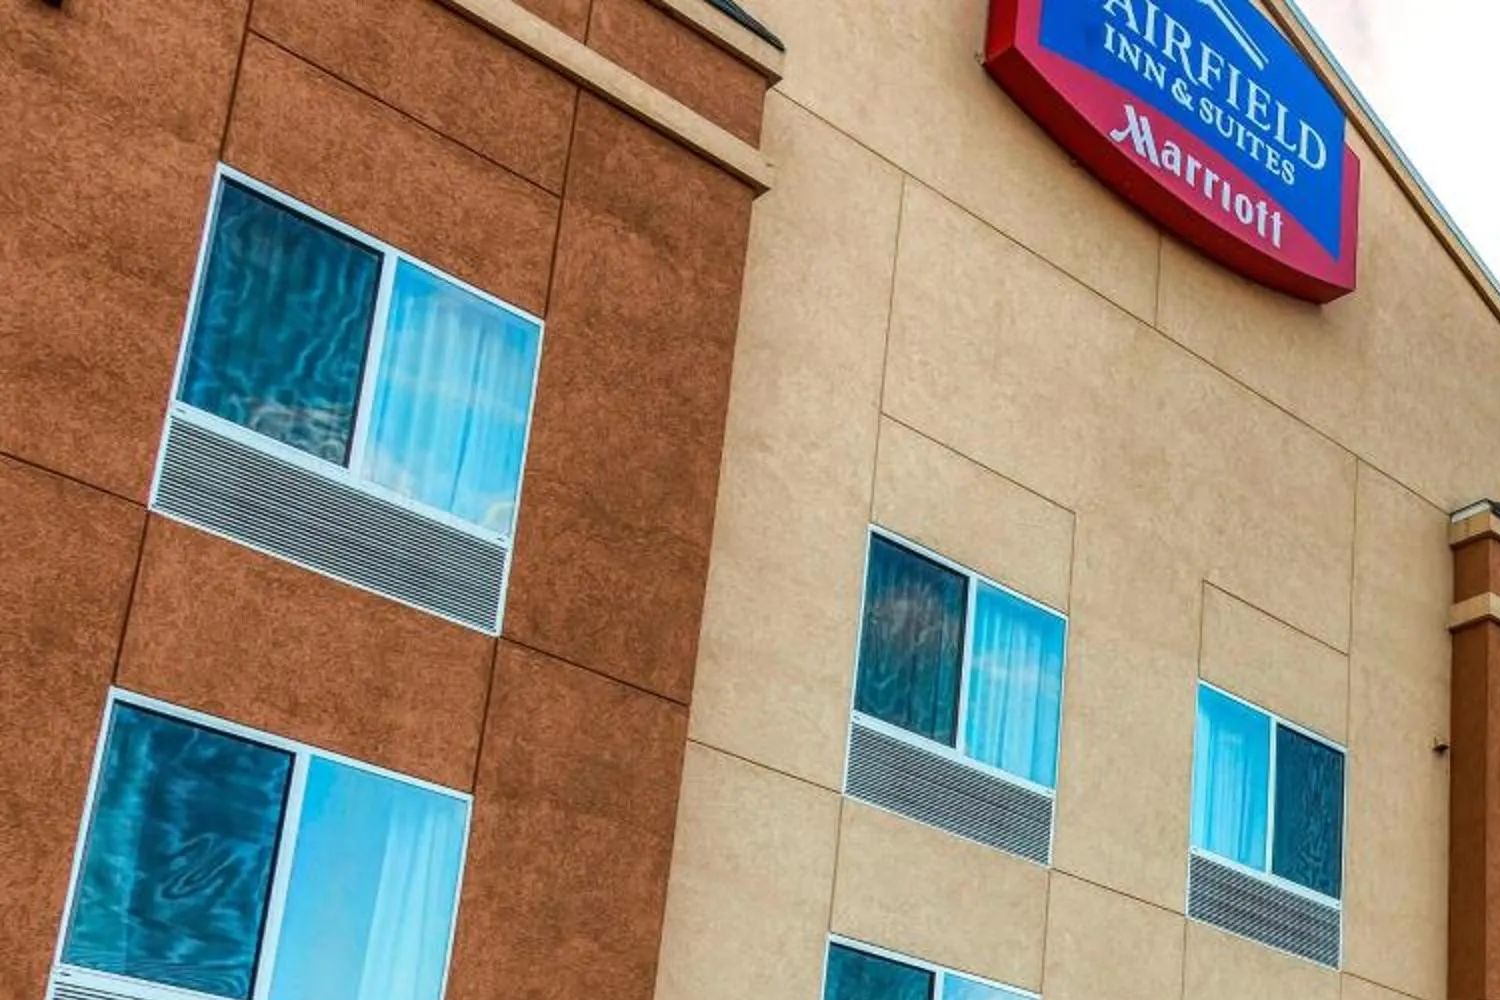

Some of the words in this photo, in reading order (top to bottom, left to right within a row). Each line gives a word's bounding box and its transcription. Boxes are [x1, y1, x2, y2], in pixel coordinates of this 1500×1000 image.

[1104, 22, 1167, 89] INN
[1171, 77, 1194, 112] &
[1199, 97, 1295, 185] SUITES
[1109, 103, 1283, 249] Marriott
